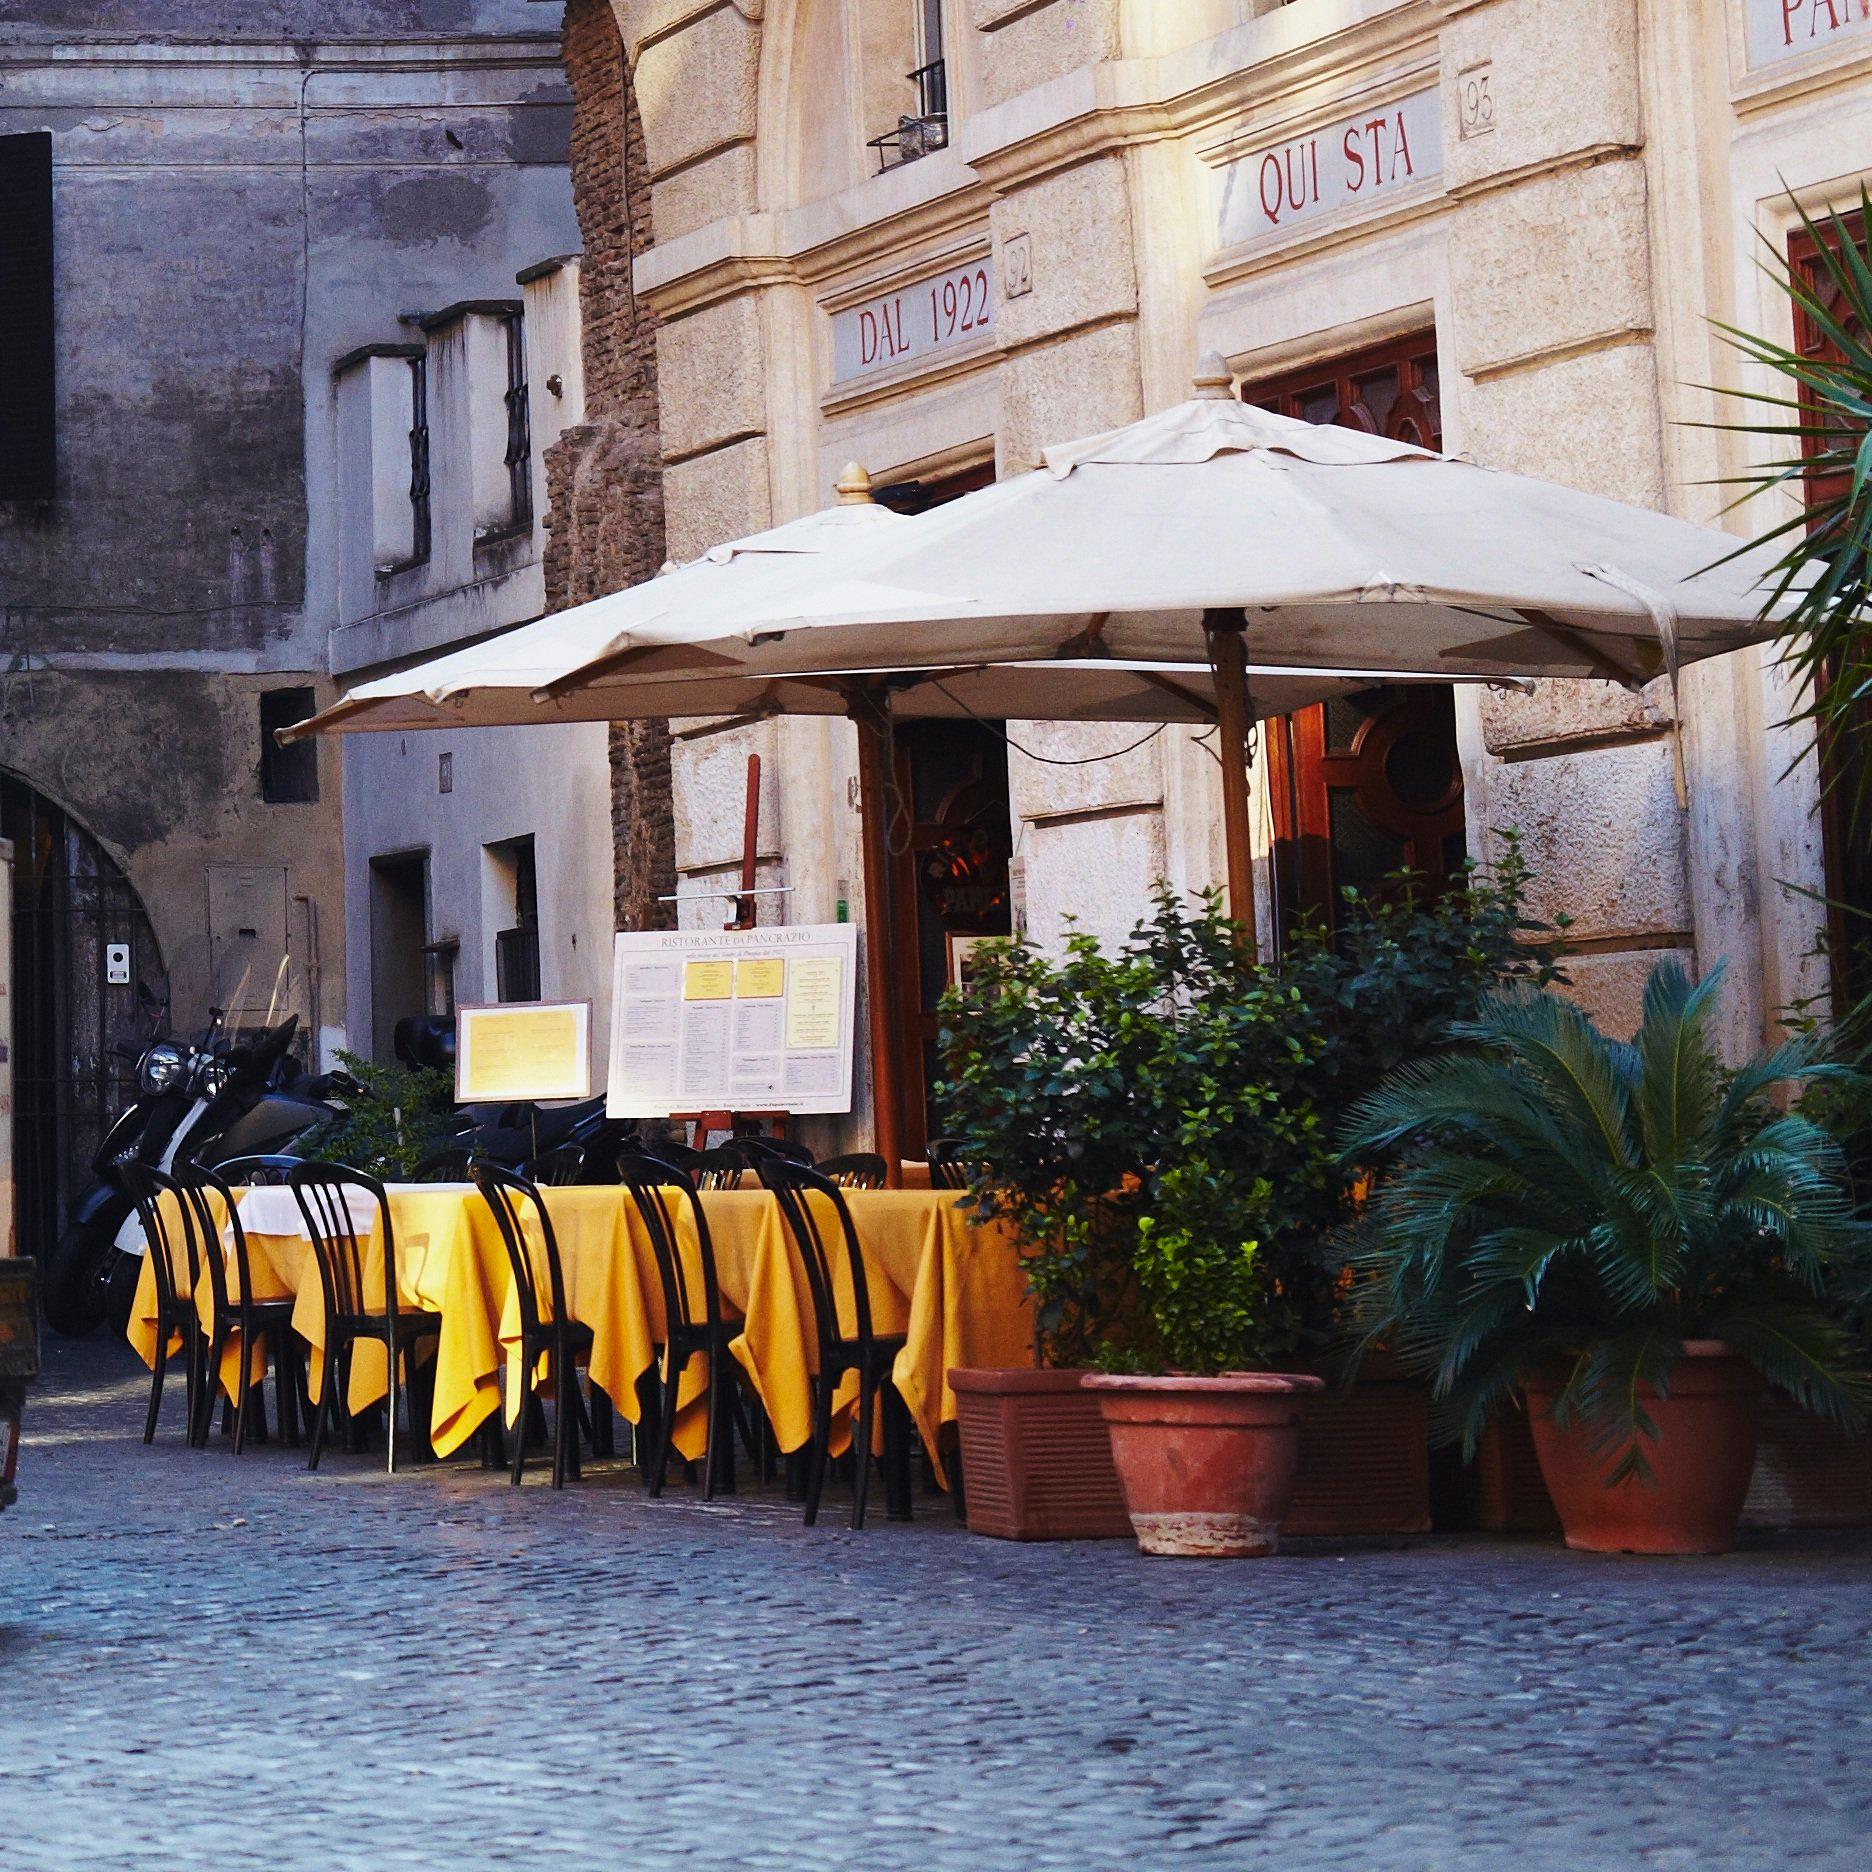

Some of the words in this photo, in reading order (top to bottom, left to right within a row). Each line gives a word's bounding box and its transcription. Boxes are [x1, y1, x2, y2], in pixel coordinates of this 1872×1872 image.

[1466, 76, 1493, 126] 93
[1260, 140, 1320, 224] QUI
[1343, 111, 1413, 192] STA
[860, 297, 910, 366] DAL
[931, 268, 990, 343] 1922
[661, 935, 732, 948] RISTORANTE
[746, 932, 812, 944] PANCRAZIO
